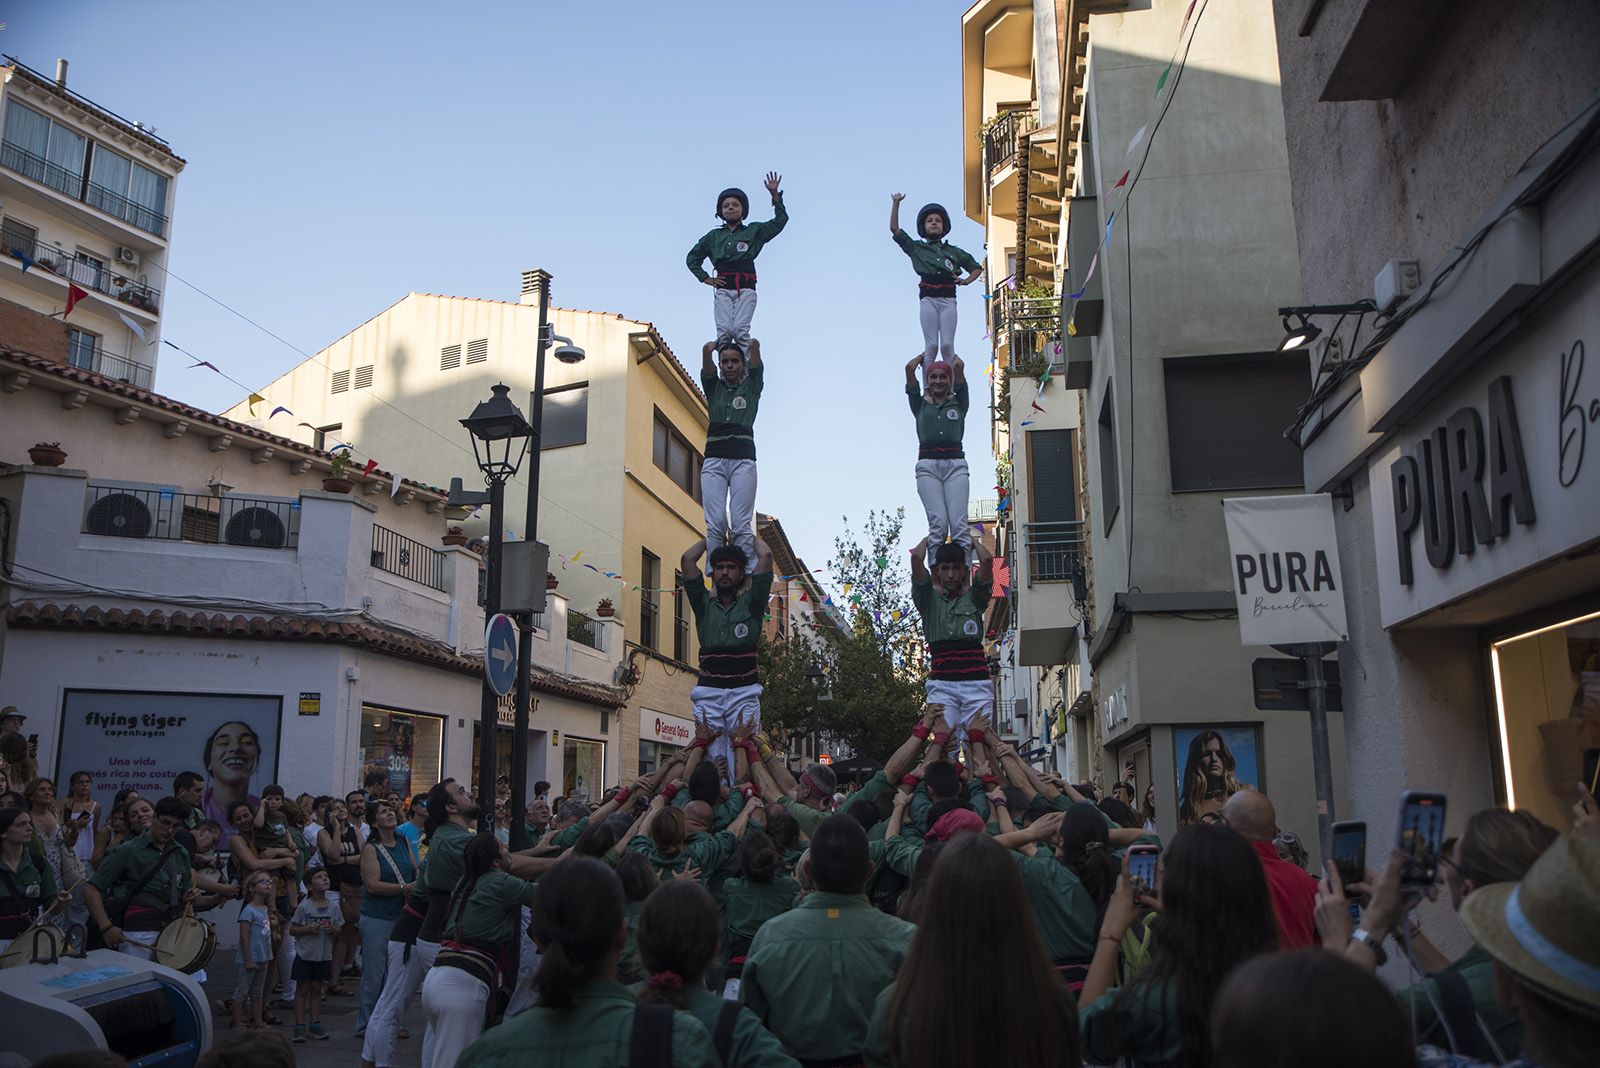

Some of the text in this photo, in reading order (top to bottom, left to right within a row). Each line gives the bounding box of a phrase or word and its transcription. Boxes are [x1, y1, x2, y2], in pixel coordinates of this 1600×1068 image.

[1391, 375, 1536, 586] PURA
[1235, 550, 1336, 595] PURA
[1253, 596, 1328, 618] Barcelona
[85, 712, 187, 729] flying tiger
[105, 729, 165, 738] copenhagen
[109, 757, 156, 766] Una vida
[388, 755, 410, 772] 30%
[110, 769, 129, 778] rica
[149, 770, 177, 778] costa
[121, 781, 163, 791] fortuna.
